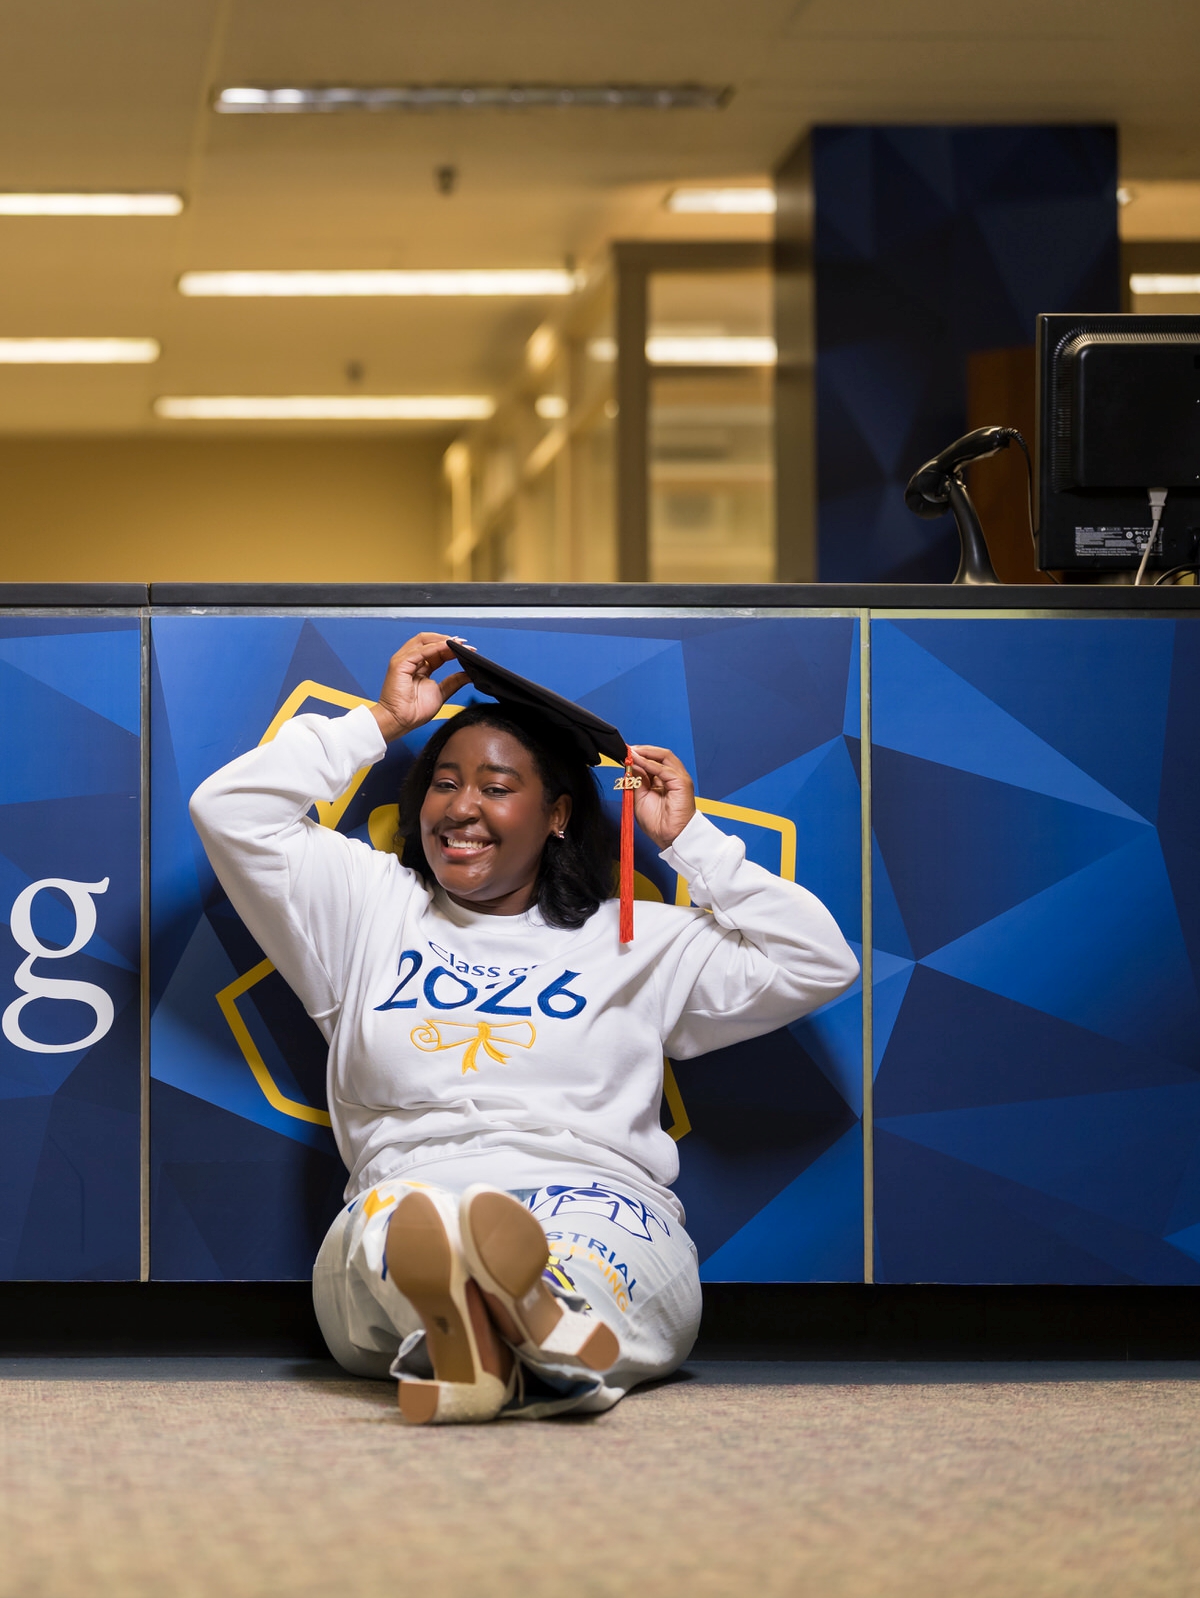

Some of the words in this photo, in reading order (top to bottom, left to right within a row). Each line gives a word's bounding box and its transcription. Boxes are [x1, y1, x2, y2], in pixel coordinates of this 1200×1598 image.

[613, 776, 642, 790] 2026
[373, 949, 588, 1020] 2026
[428, 940, 501, 978] Class
[508, 964, 539, 976] o
[545, 1230, 637, 1302] STRIAL
[548, 1241, 629, 1313] EERING
